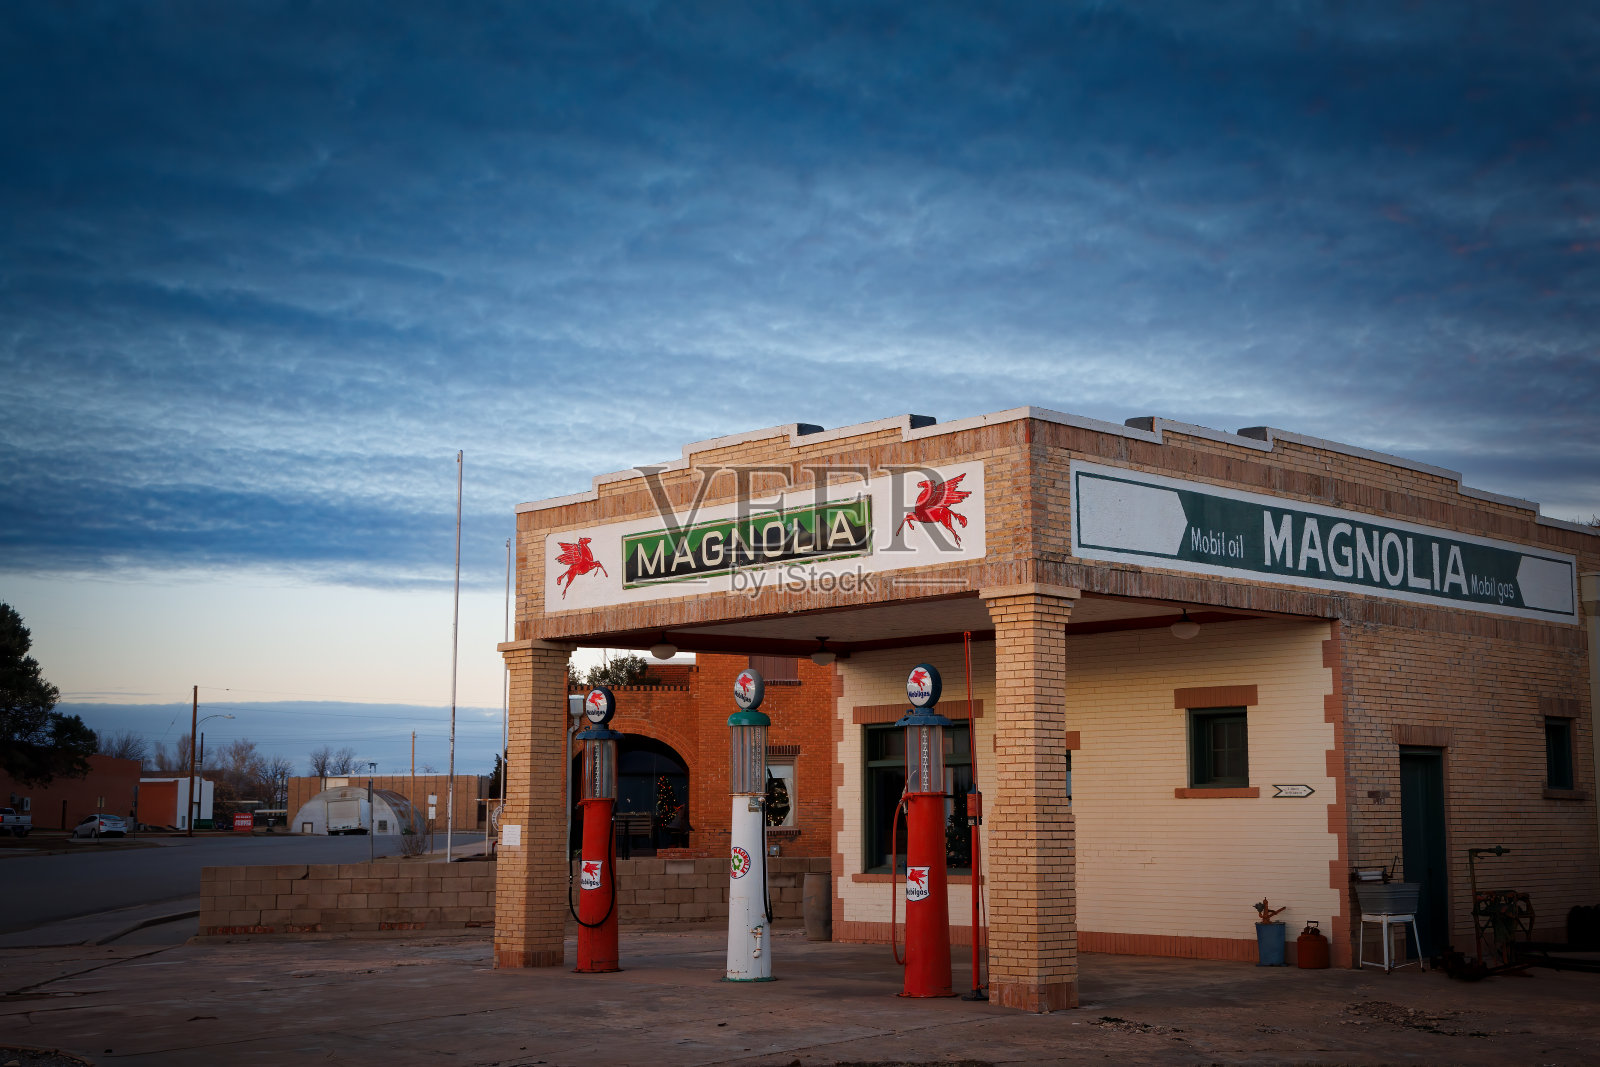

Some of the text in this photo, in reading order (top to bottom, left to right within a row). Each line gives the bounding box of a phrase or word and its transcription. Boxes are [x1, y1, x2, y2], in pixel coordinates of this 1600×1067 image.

[637, 511, 857, 577] MAGNOLIA
[1191, 526, 1244, 559] Mobil oil
[1263, 510, 1469, 595] MAGNOLIA
[1471, 573, 1515, 604] Mobil gas
[908, 690, 931, 699] Mobilgas
